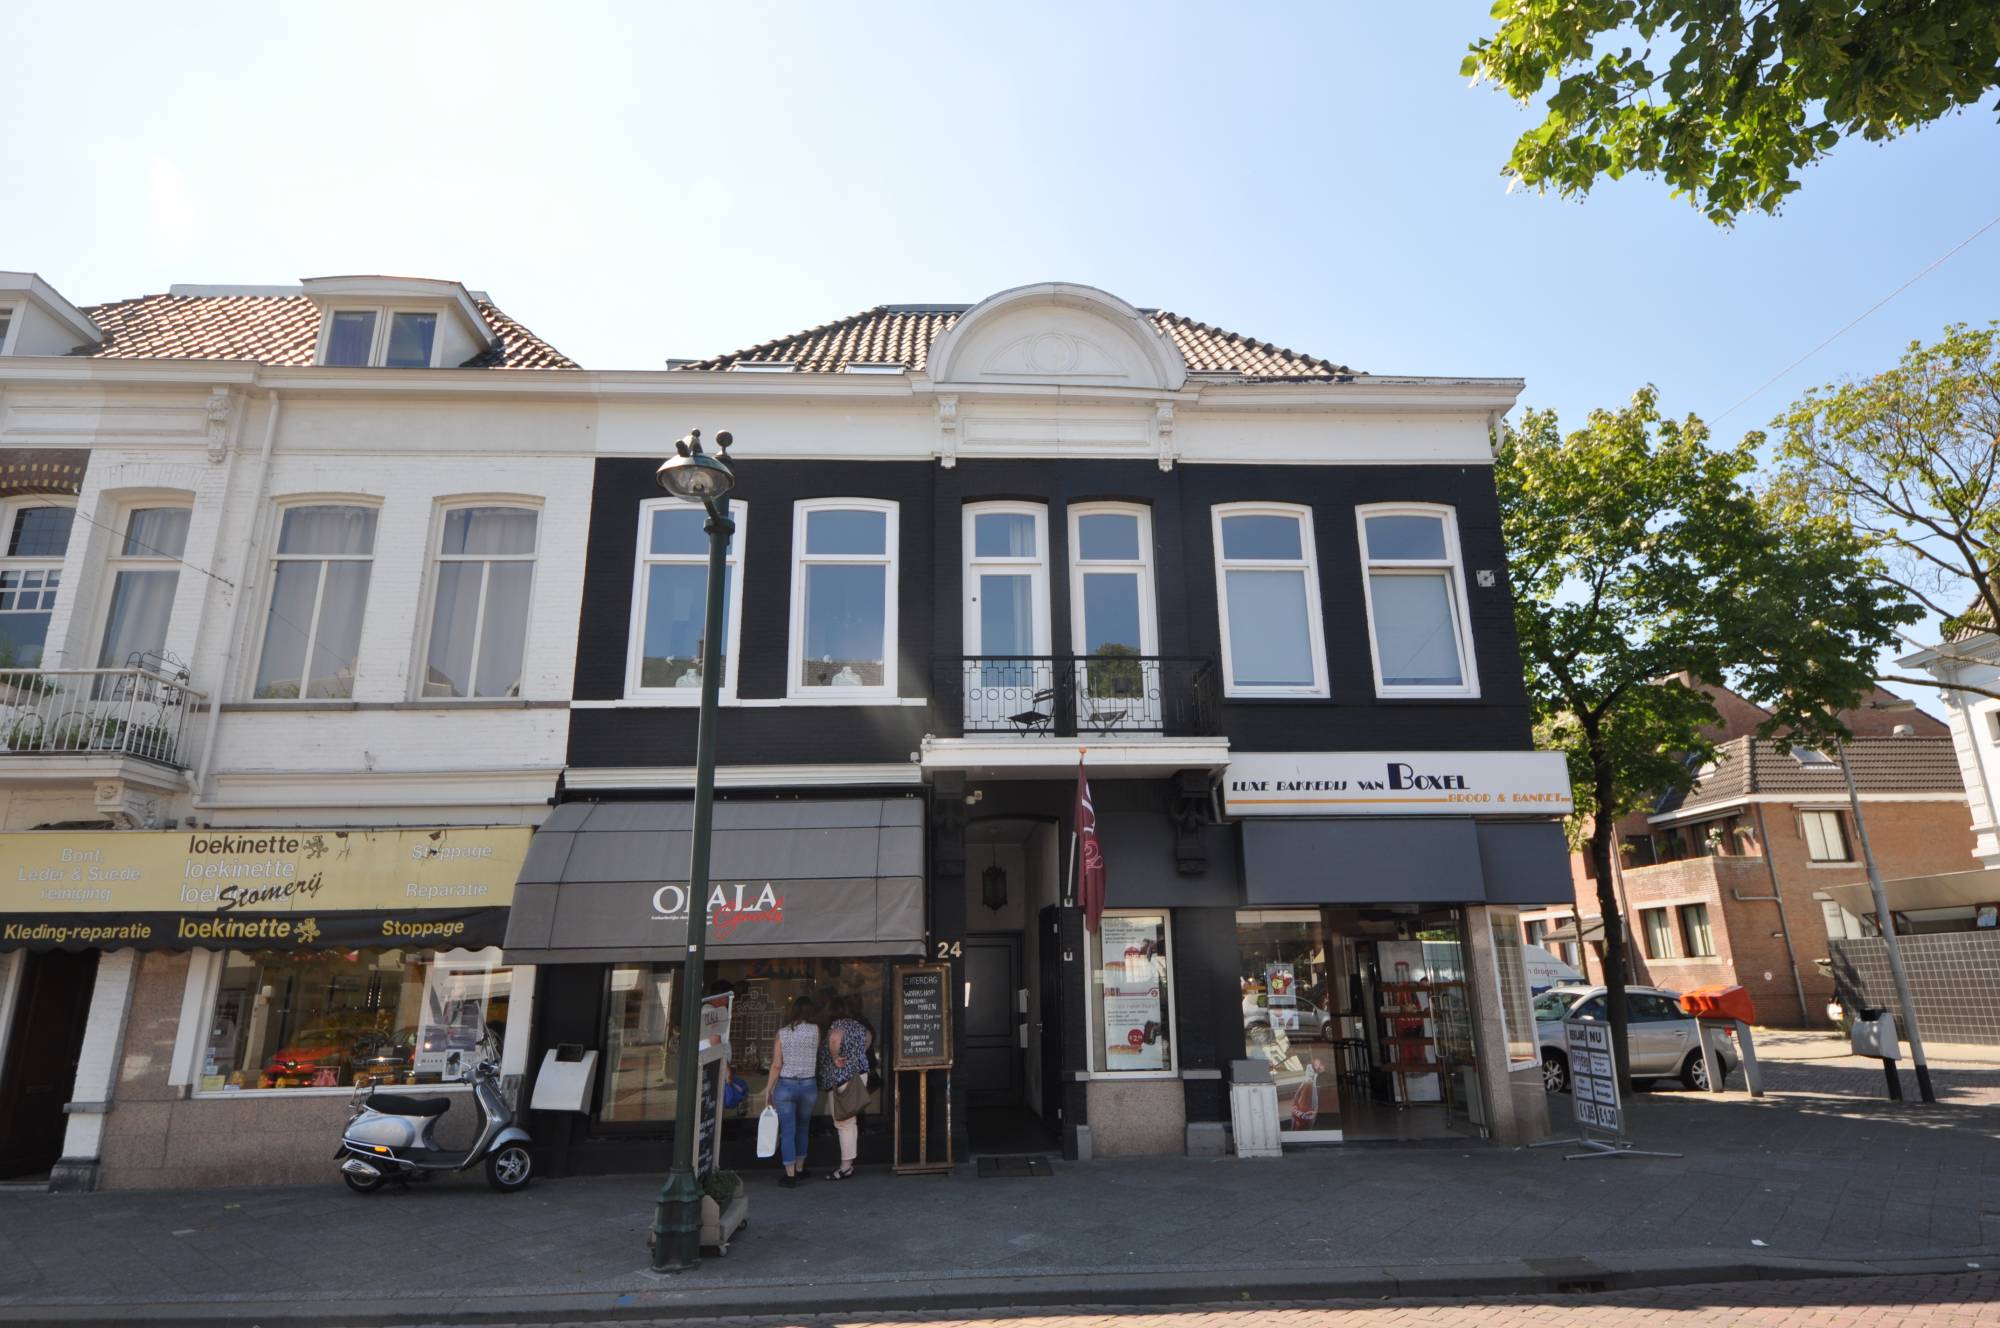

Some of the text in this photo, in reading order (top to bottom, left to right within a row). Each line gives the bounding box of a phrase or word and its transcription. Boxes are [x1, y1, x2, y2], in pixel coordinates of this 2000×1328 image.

[1232, 781, 1269, 791] LUXE
[1276, 780, 1347, 791] BAKKERIJ
[1357, 780, 1384, 791] VAN
[1448, 793, 1492, 803] BROOD
[1497, 792, 1506, 803] &
[188, 835, 299, 854] loekinette
[71, 866, 82, 881] &
[87, 865, 142, 881] Suede
[184, 859, 295, 879] loekinette
[216, 872, 324, 912] Stomerij
[405, 883, 489, 902] Reparatie
[4, 923, 152, 942] Kleding-reparatie
[177, 917, 290, 938] loekinette
[382, 920, 465, 938] Stoppage
[937, 941, 962, 959] 24
[1589, 1031, 1602, 1044] NU
